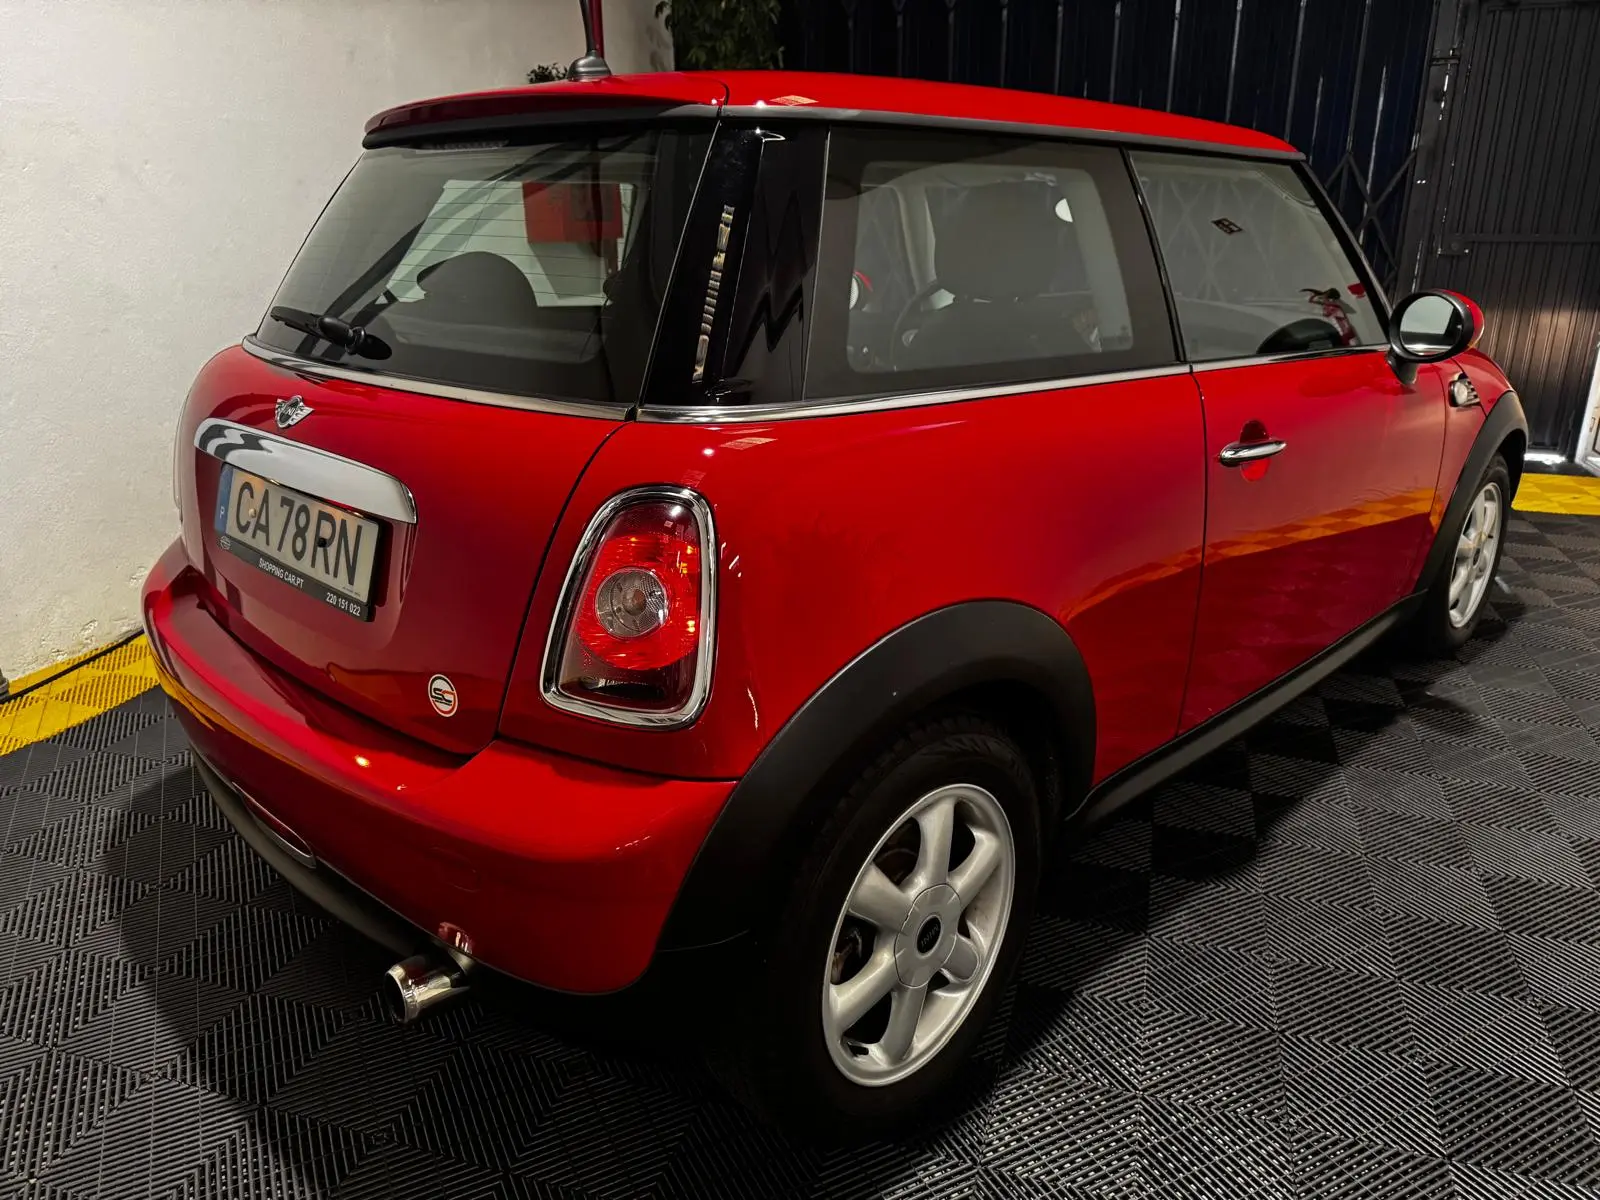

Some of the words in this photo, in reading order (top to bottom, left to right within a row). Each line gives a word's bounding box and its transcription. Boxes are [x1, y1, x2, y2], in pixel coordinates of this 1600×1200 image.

[219, 505, 225, 519] P
[259, 557, 284, 579] SHOPPING
[326, 592, 337, 605] 220
[338, 597, 348, 610] 151
[349, 603, 361, 616] 022
